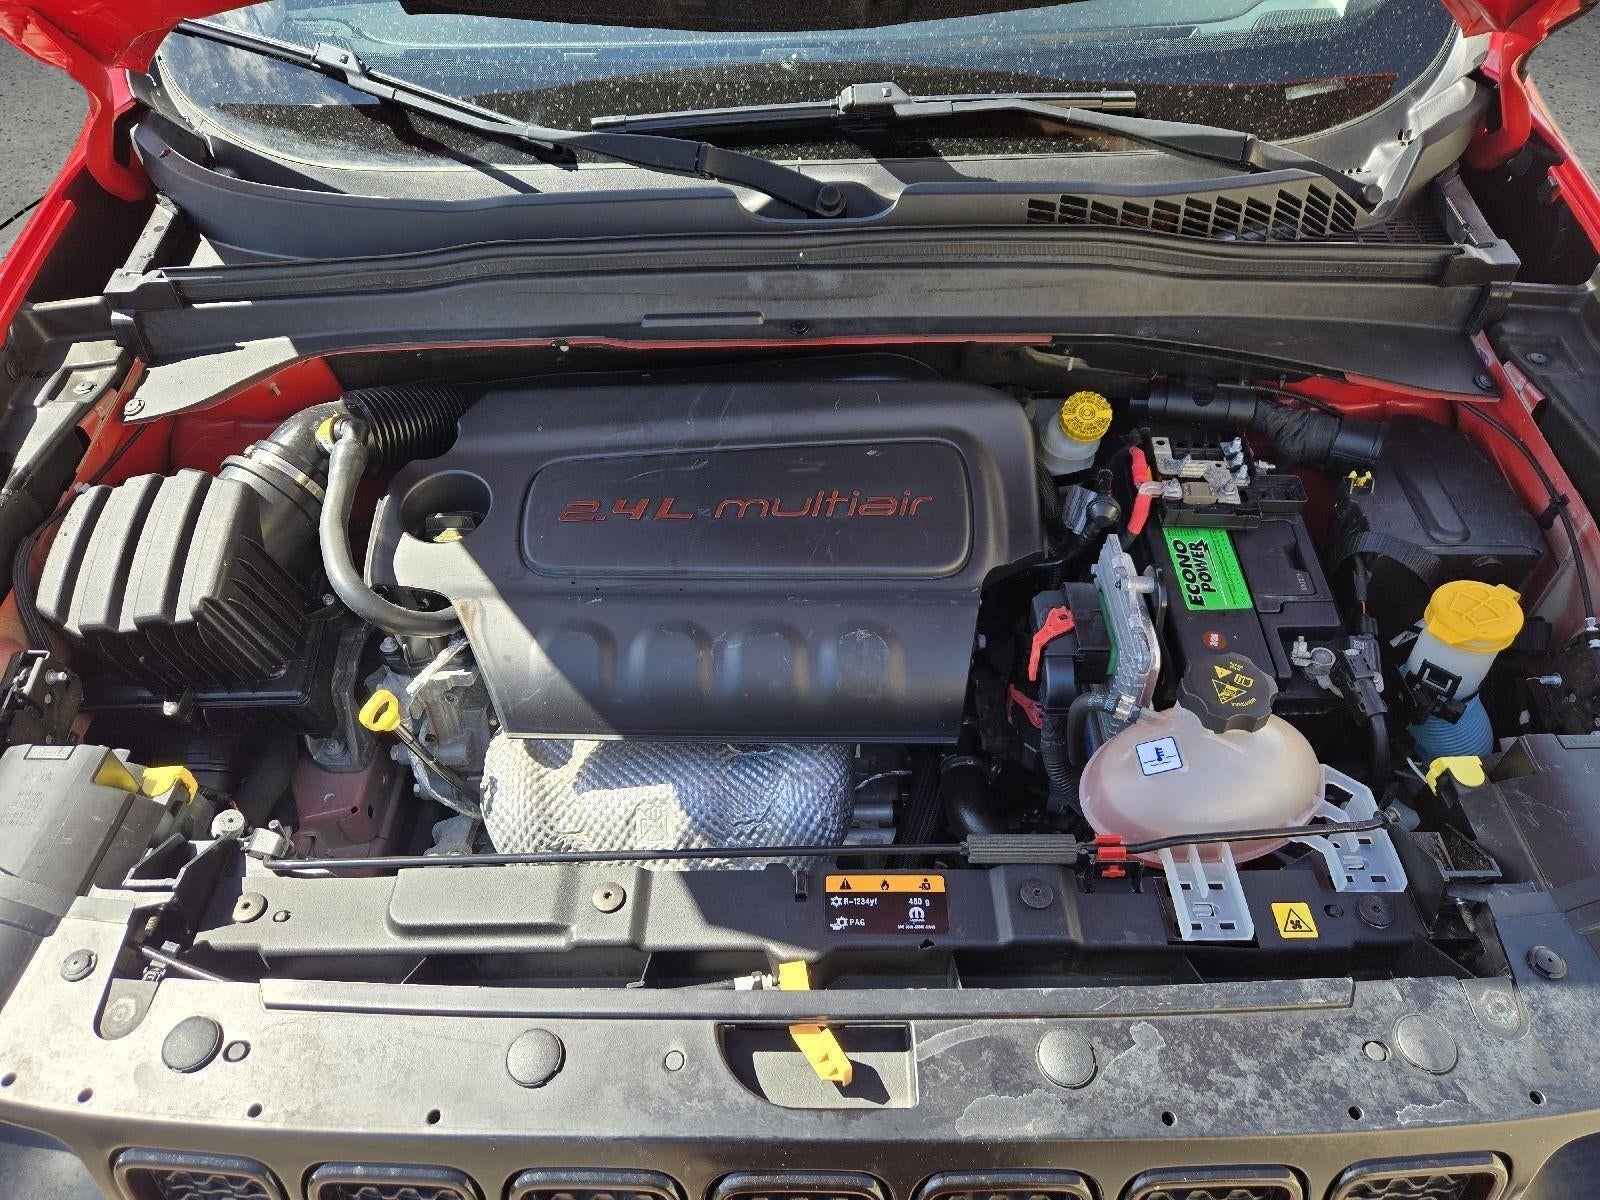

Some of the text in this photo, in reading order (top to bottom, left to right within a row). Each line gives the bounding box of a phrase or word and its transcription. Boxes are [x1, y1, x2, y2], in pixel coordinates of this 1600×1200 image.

[714, 489, 933, 519] multiair
[1171, 538, 1206, 607] ECONO
[1187, 538, 1217, 593] POWER
[849, 918, 866, 927] PAG
